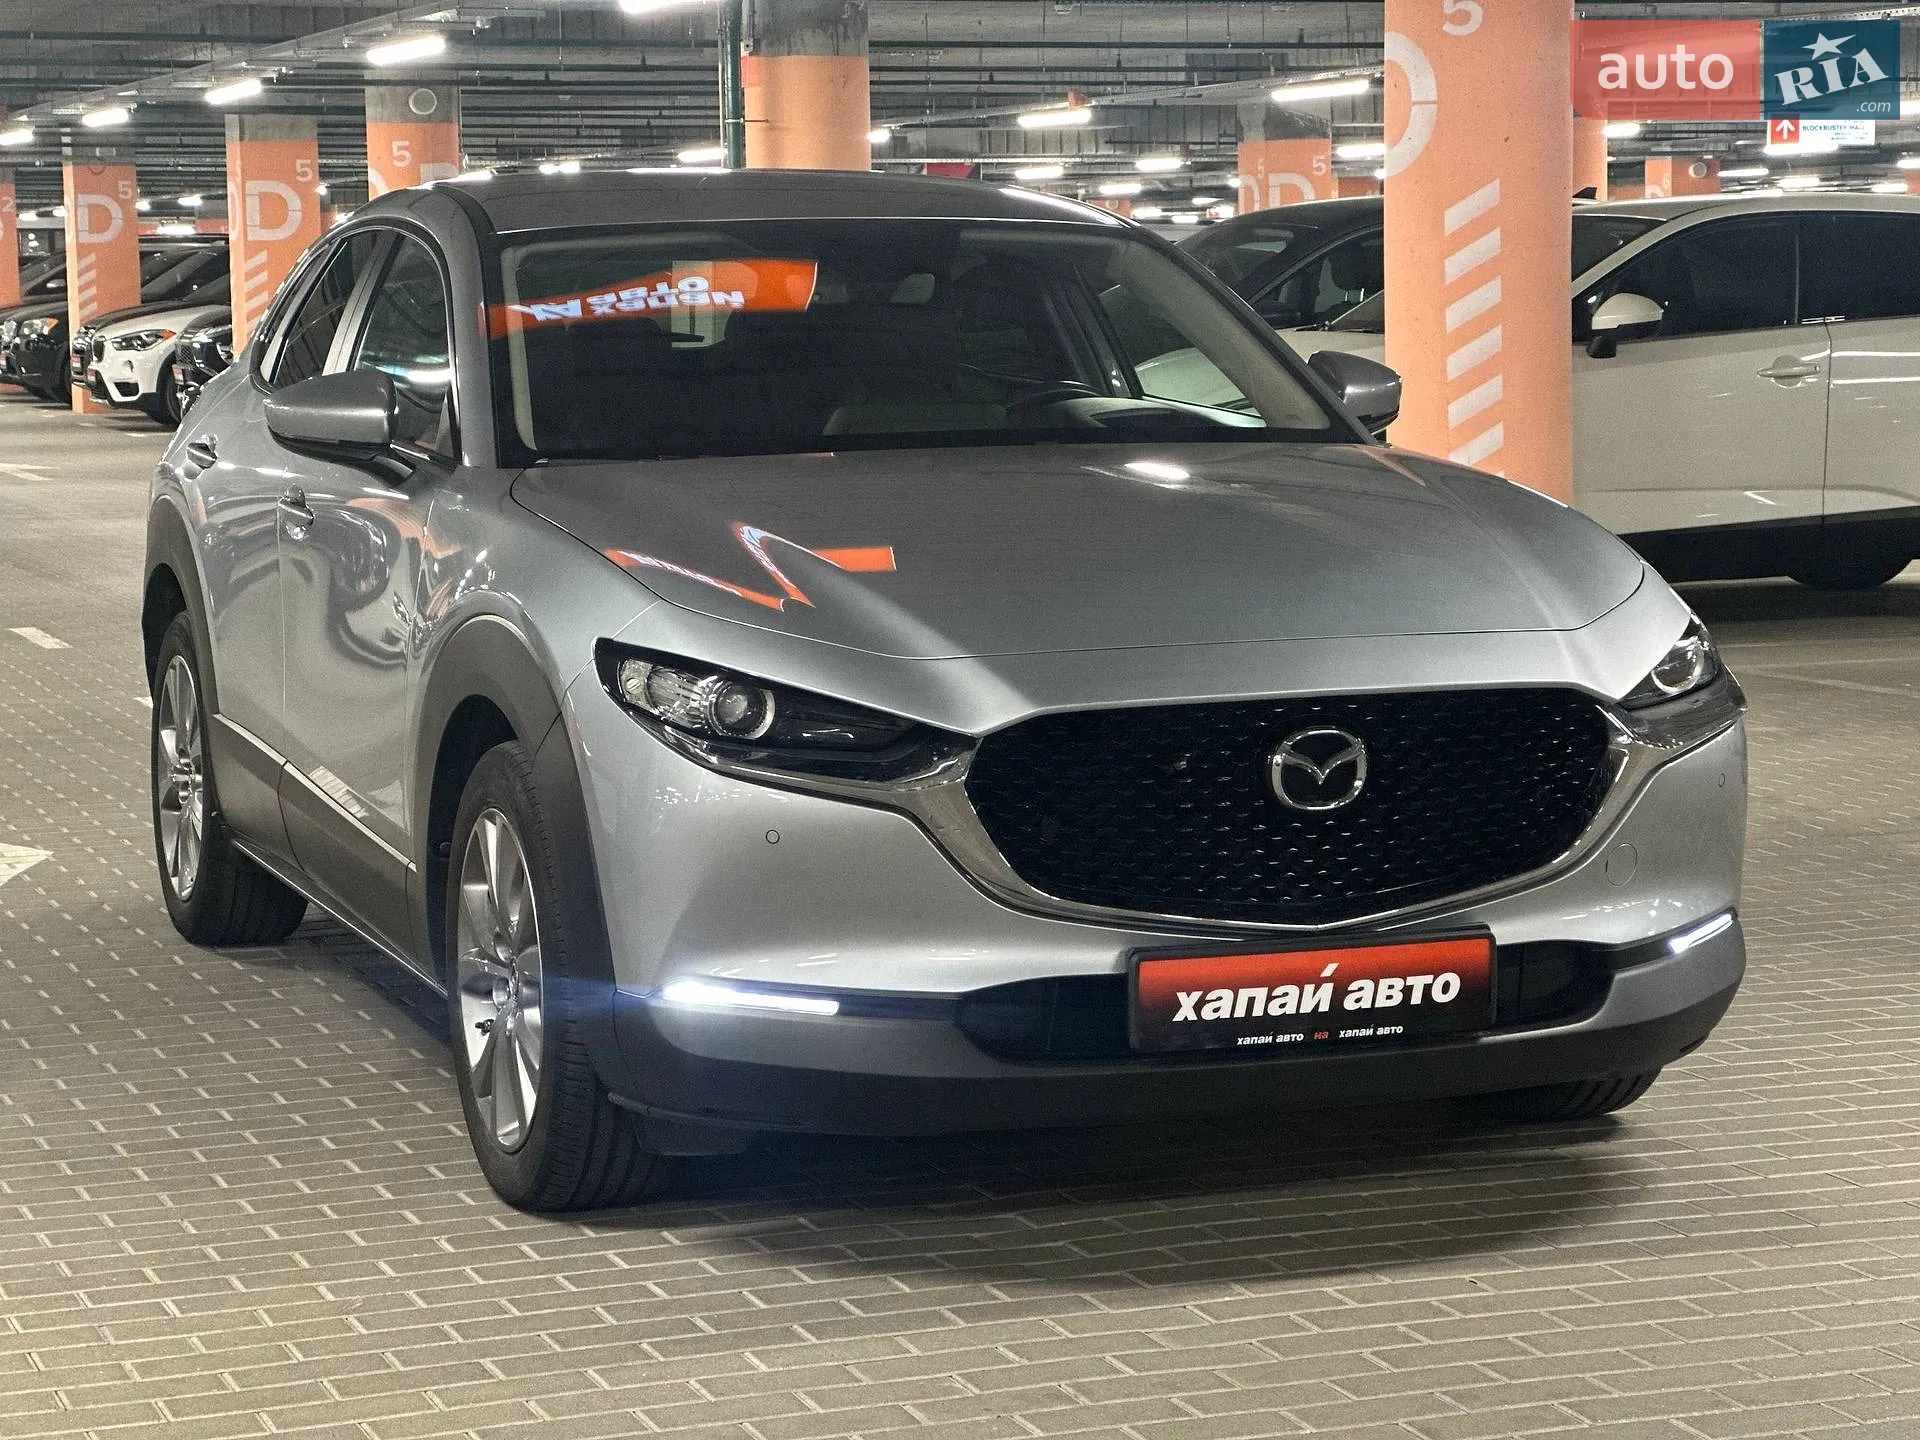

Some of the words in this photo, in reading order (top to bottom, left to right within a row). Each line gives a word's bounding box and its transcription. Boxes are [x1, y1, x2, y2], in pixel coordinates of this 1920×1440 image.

[391, 140, 412, 168] 5
[1312, 155, 1328, 177] 5
[78, 194, 124, 243] D
[118, 181, 133, 200] 5
[245, 180, 303, 242] D
[295, 159, 313, 182] 5
[1342, 971, 1461, 1010] авто
[1275, 1032, 1304, 1043] авто
[1376, 1025, 1404, 1036] авто
